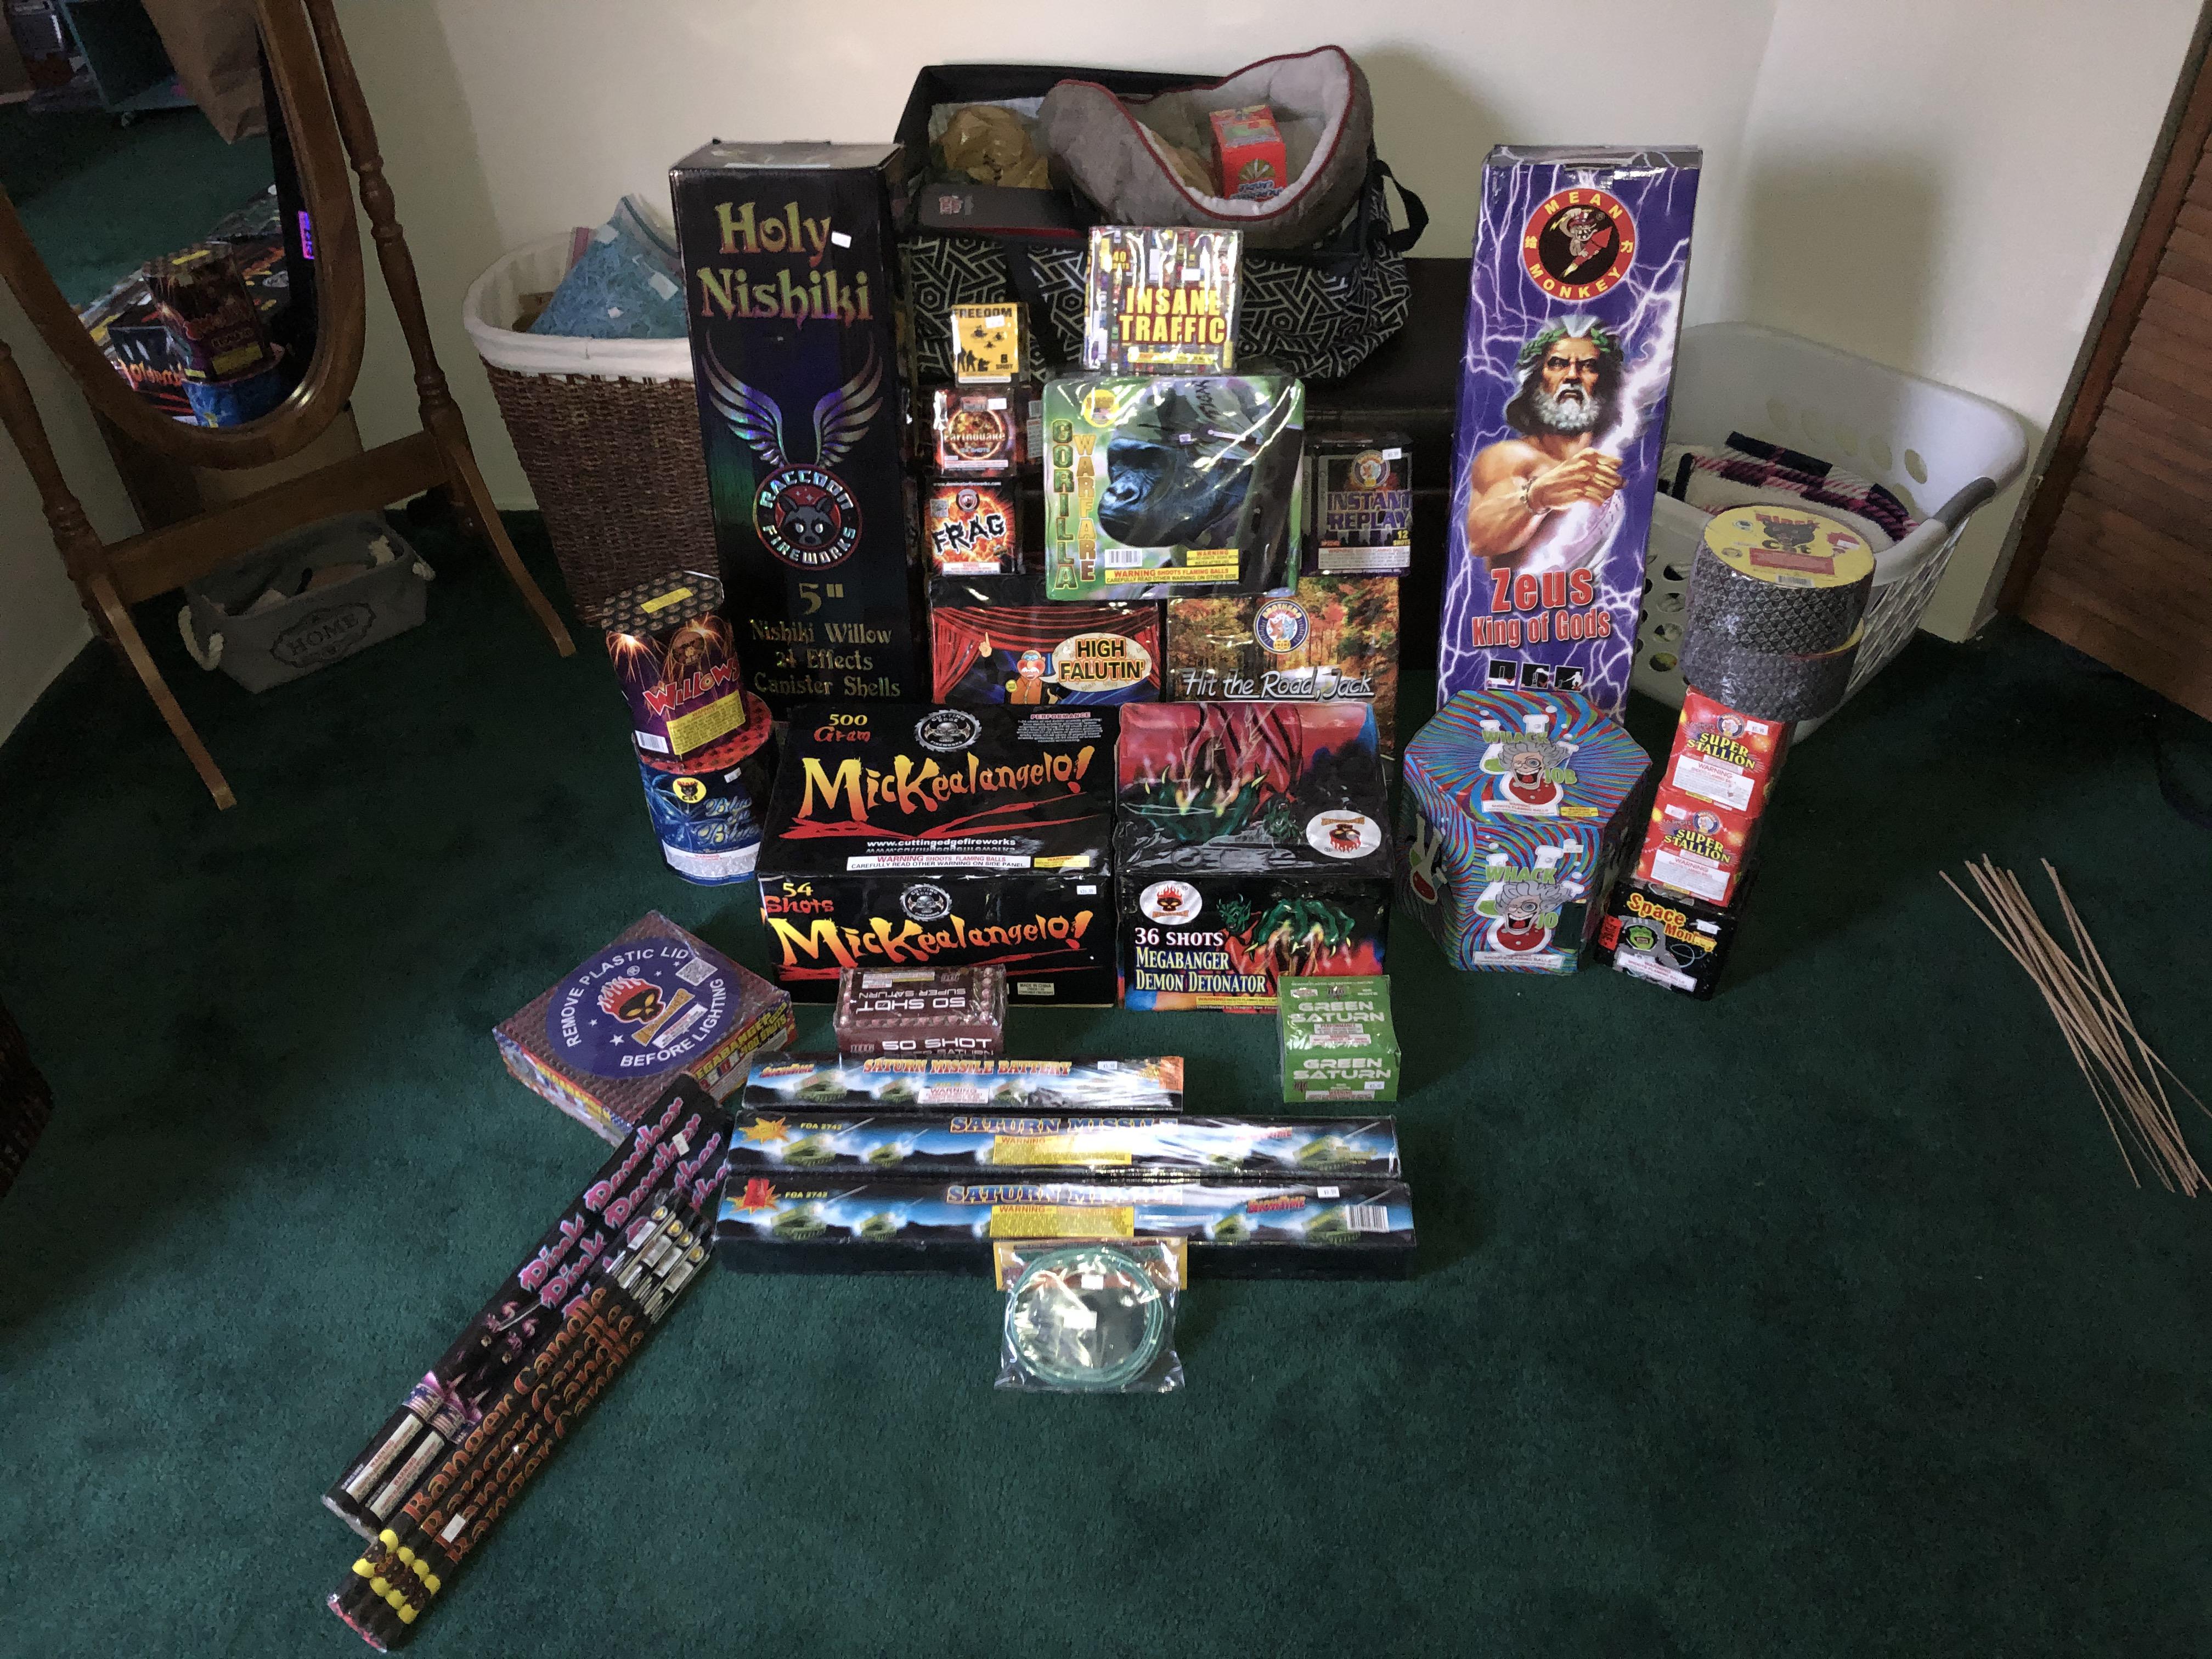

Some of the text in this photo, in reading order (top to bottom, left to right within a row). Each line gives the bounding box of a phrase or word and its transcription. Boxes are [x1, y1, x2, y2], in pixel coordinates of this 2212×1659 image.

[1544, 191, 1622, 219] MEAN
[714, 201, 831, 268] Holy
[1528, 263, 1621, 299] MONKEY
[696, 267, 873, 330] Nishiki
[1126, 287, 1220, 315] INSANE
[1119, 315, 1227, 343] TRAFFIC
[759, 469, 854, 510] RACCOON
[1327, 492, 1410, 512] INSTANT
[1052, 419, 1078, 590] GORILLA
[1074, 435, 1097, 581] WARFARE
[1328, 511, 1407, 531] REPLAY
[763, 525, 857, 566] FIREWORKS
[932, 514, 1006, 555] FRAG
[1397, 529, 1408, 539] 12
[1114, 569, 1156, 578] WARNING
[1491, 567, 1594, 613] Zeus
[823, 622, 893, 645] Willow
[1471, 607, 1611, 648] King of Gods
[806, 648, 874, 671] Effects
[1076, 639, 1126, 659] HIGH
[1059, 660, 1146, 681] FALUTIN'
[754, 671, 901, 697] Canister Shells
[1183, 668, 1374, 701] Hit the Road, Jack
[829, 714, 868, 726] 500
[814, 726, 871, 743] Gram
[1482, 731, 1549, 744] WHACK
[1700, 732, 1750, 758] SUPER
[1686, 739, 1756, 770] STALLION
[1664, 834, 1731, 864] STALLION
[1676, 828, 1724, 853] SUPER
[1485, 865, 1558, 885] WHACK
[782, 882, 813, 898] 54
[764, 895, 834, 914] Shots
[1627, 893, 1686, 926] Space
[1535, 911, 1559, 929] JO
[1135, 927, 1224, 946] 36 SHOTS
[579, 946, 690, 986] PLASTIC LID
[856, 997, 966, 1014] 50 SHOT
[858, 988, 967, 999] SUPER SATURN
[561, 987, 585, 1047] REMOVE
[692, 978, 727, 1041] LIGHTING
[1288, 1012, 1385, 1023] SATURN
[1298, 1001, 1374, 1012] GREEN
[620, 1038, 696, 1068] BEFORE
[882, 1037, 992, 1051] 50 SHOT
[862, 1058, 1072, 1076] SATURN MISSILE BATTERY
[1293, 1069, 1391, 1080] SATURN
[1303, 1057, 1383, 1069] GREEN
[950, 1116, 1062, 1134] SATURN
[946, 1185, 1060, 1205] SATURN
[518, 1212, 586, 1292] Pink
[540, 1231, 605, 1309] Pink
[402, 1287, 607, 1522] Banger Candle
[435, 1422, 543, 1550] anger
